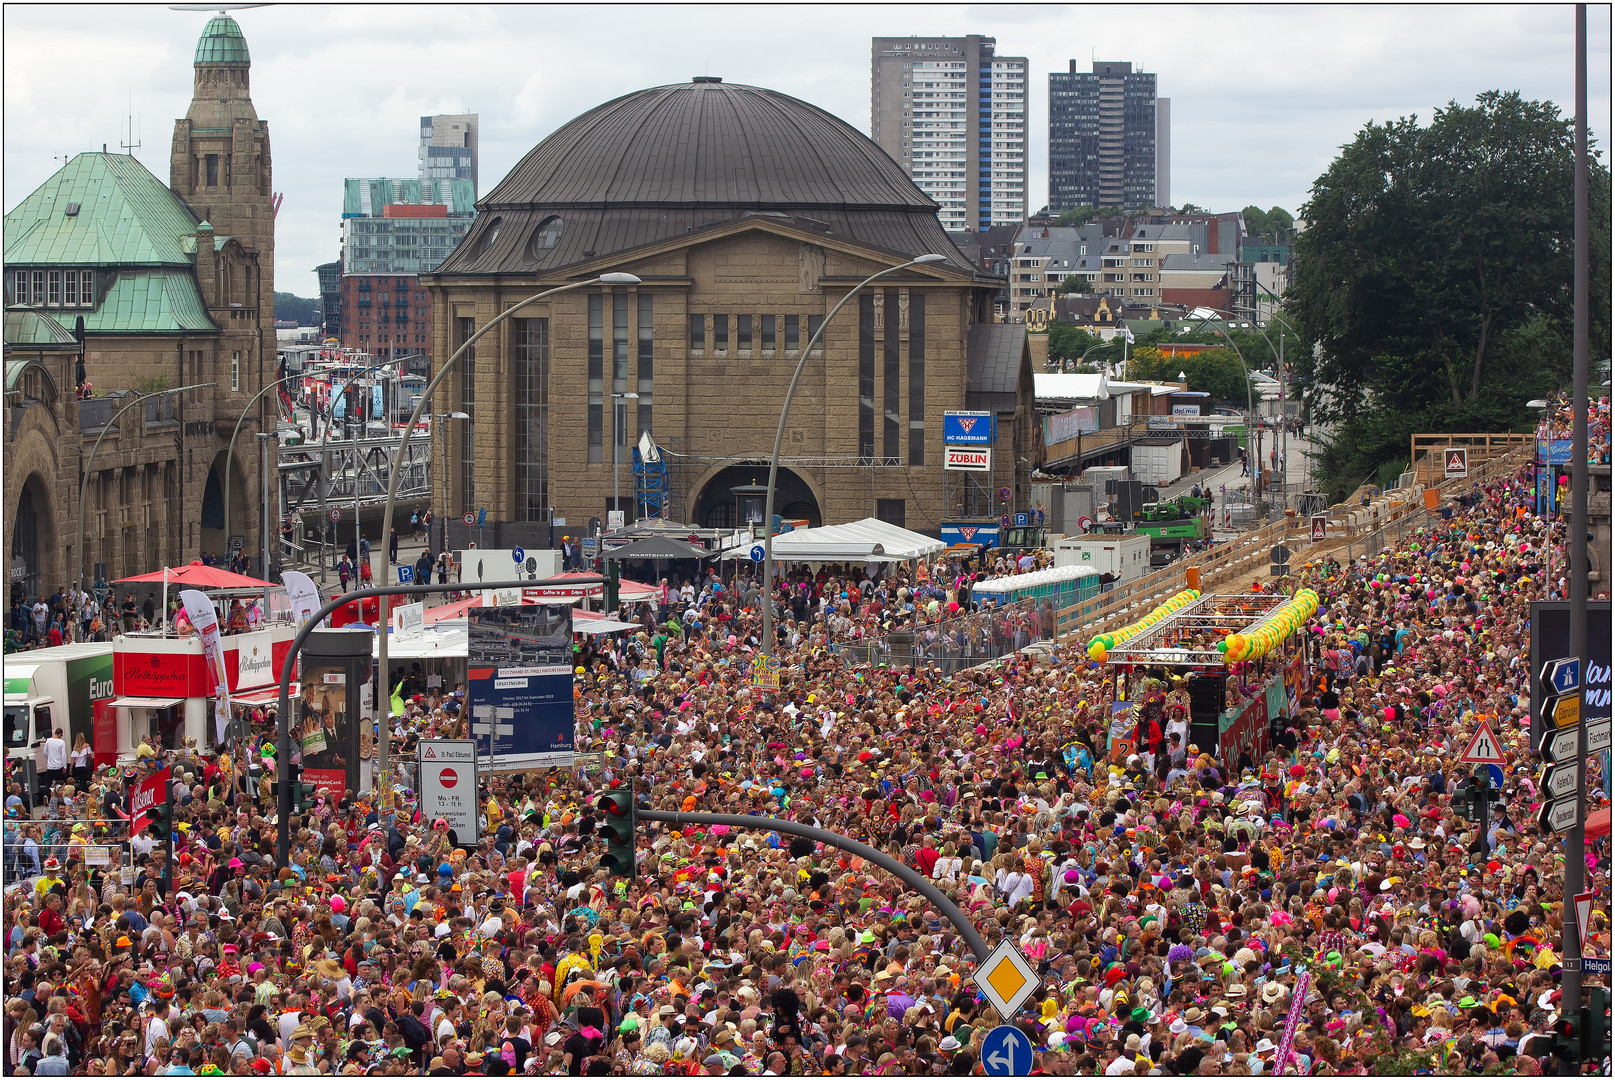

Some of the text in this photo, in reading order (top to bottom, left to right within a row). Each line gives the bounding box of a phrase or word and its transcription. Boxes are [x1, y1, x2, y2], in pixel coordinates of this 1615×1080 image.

[949, 453, 986, 464] ZÜBLIN
[124, 666, 187, 684] Rotkäppchen
[1558, 706, 1578, 721] Elbbrücken
[1559, 740, 1575, 754] Centrum
[1556, 772, 1575, 791] HafenCity
[1556, 807, 1575, 829] Speicherstadt
